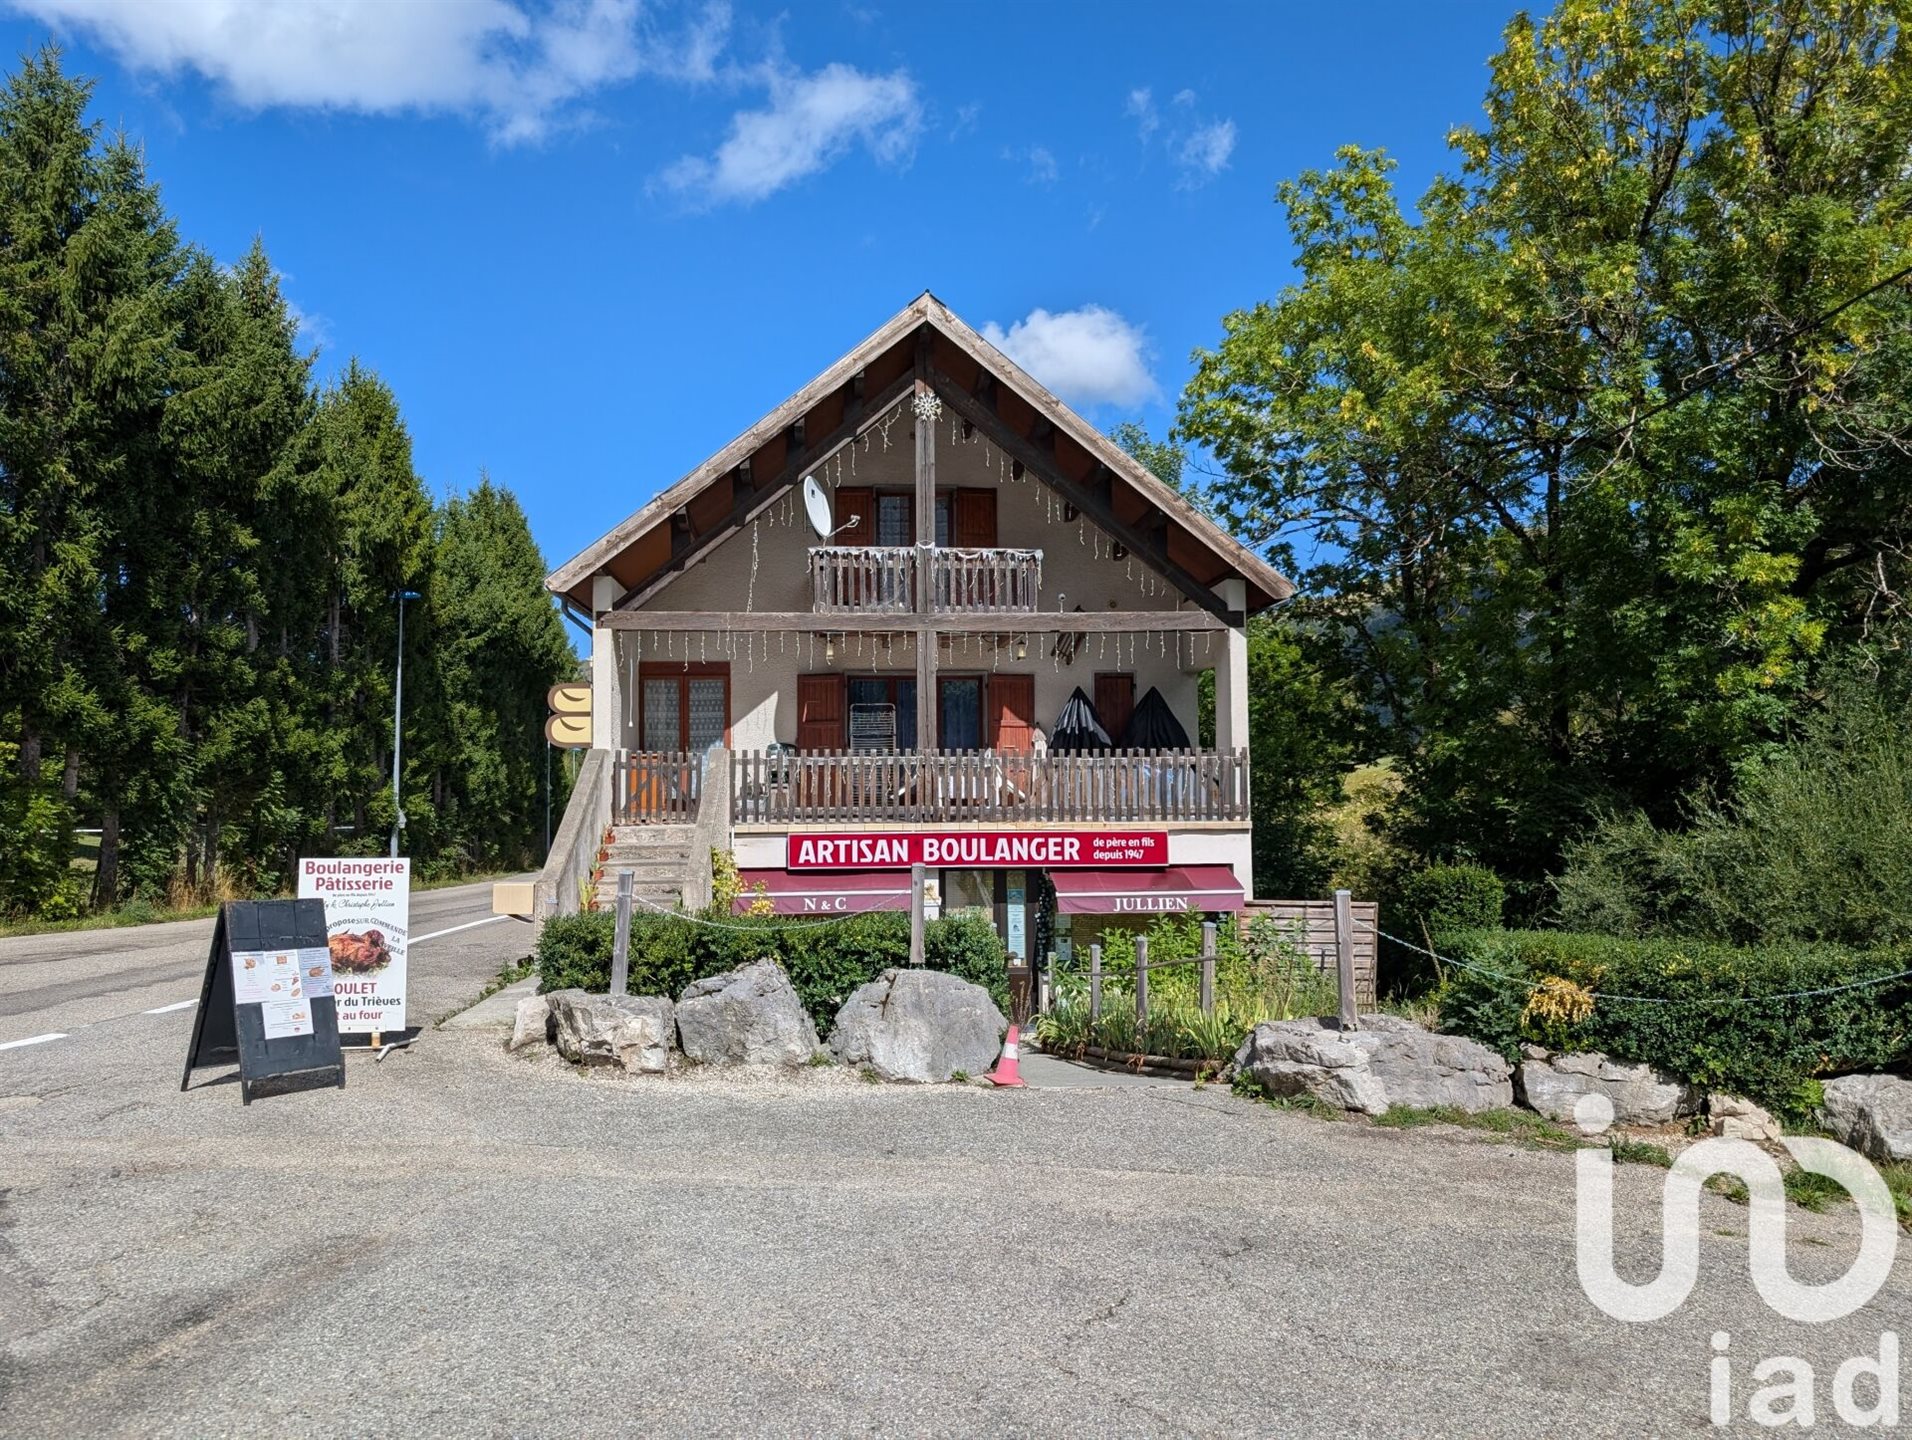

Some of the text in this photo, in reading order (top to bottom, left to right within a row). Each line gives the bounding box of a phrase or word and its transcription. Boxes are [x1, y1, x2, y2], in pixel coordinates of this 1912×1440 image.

[1093, 837, 1155, 849] de père en fils
[798, 837, 1080, 864] ARTISAN BOULANGER
[1093, 849, 1144, 861] depuis 1947
[305, 861, 405, 877] Boulangerie
[315, 877, 394, 891] Pâtisserie
[804, 897, 847, 911] N & C
[1113, 897, 1188, 912] JULLIEN
[334, 982, 377, 995] OULET
[344, 997, 358, 1007] du
[342, 1012, 357, 1020] au
[360, 1010, 383, 1020] four
